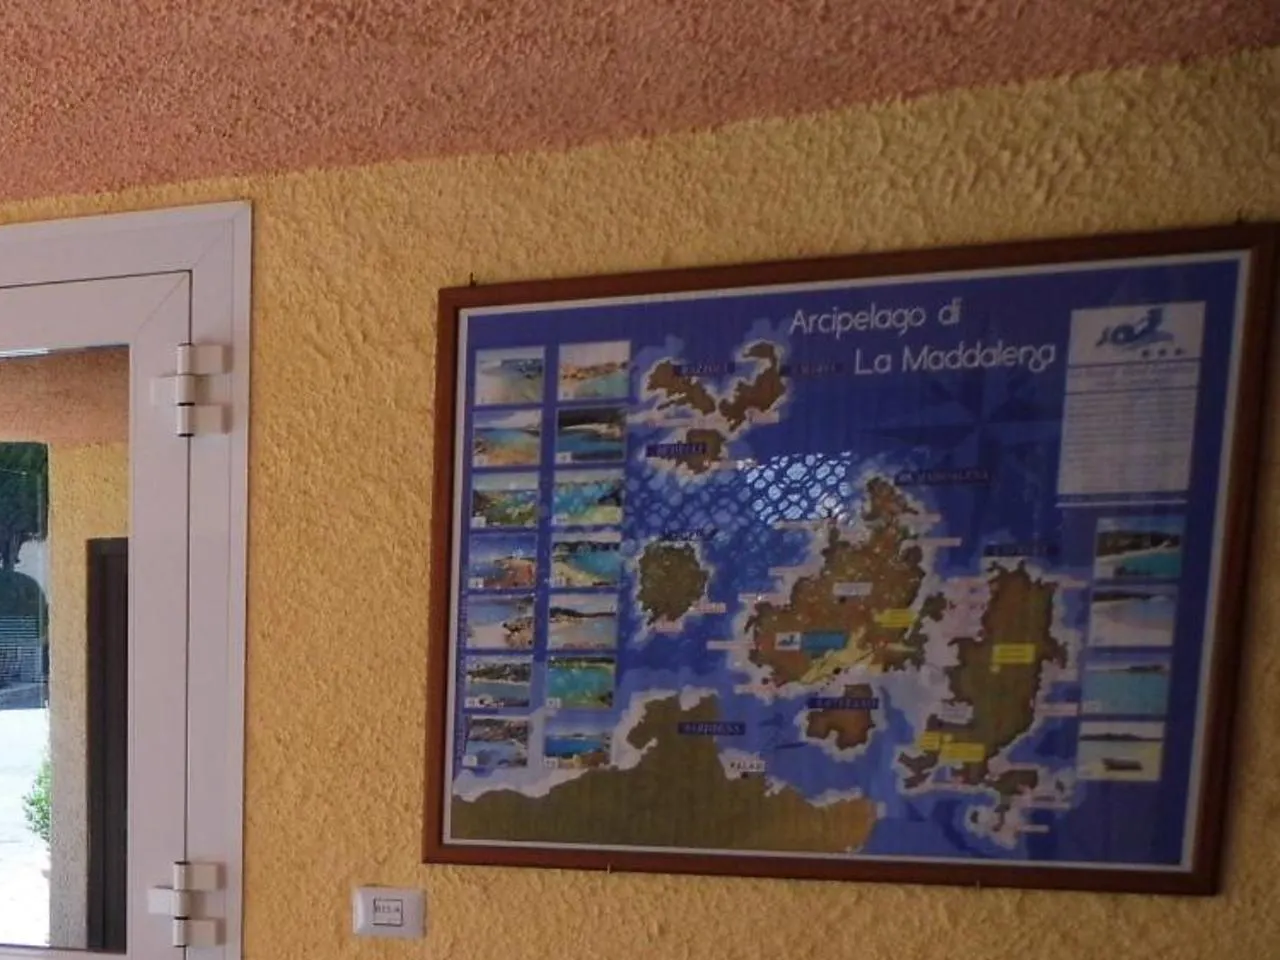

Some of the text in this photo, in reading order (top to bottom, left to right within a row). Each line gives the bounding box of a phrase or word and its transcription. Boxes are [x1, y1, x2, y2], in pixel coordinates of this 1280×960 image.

[789, 297, 964, 340] Arcipelago di
[854, 348, 892, 375] La
[902, 339, 1057, 373] Maddalena
